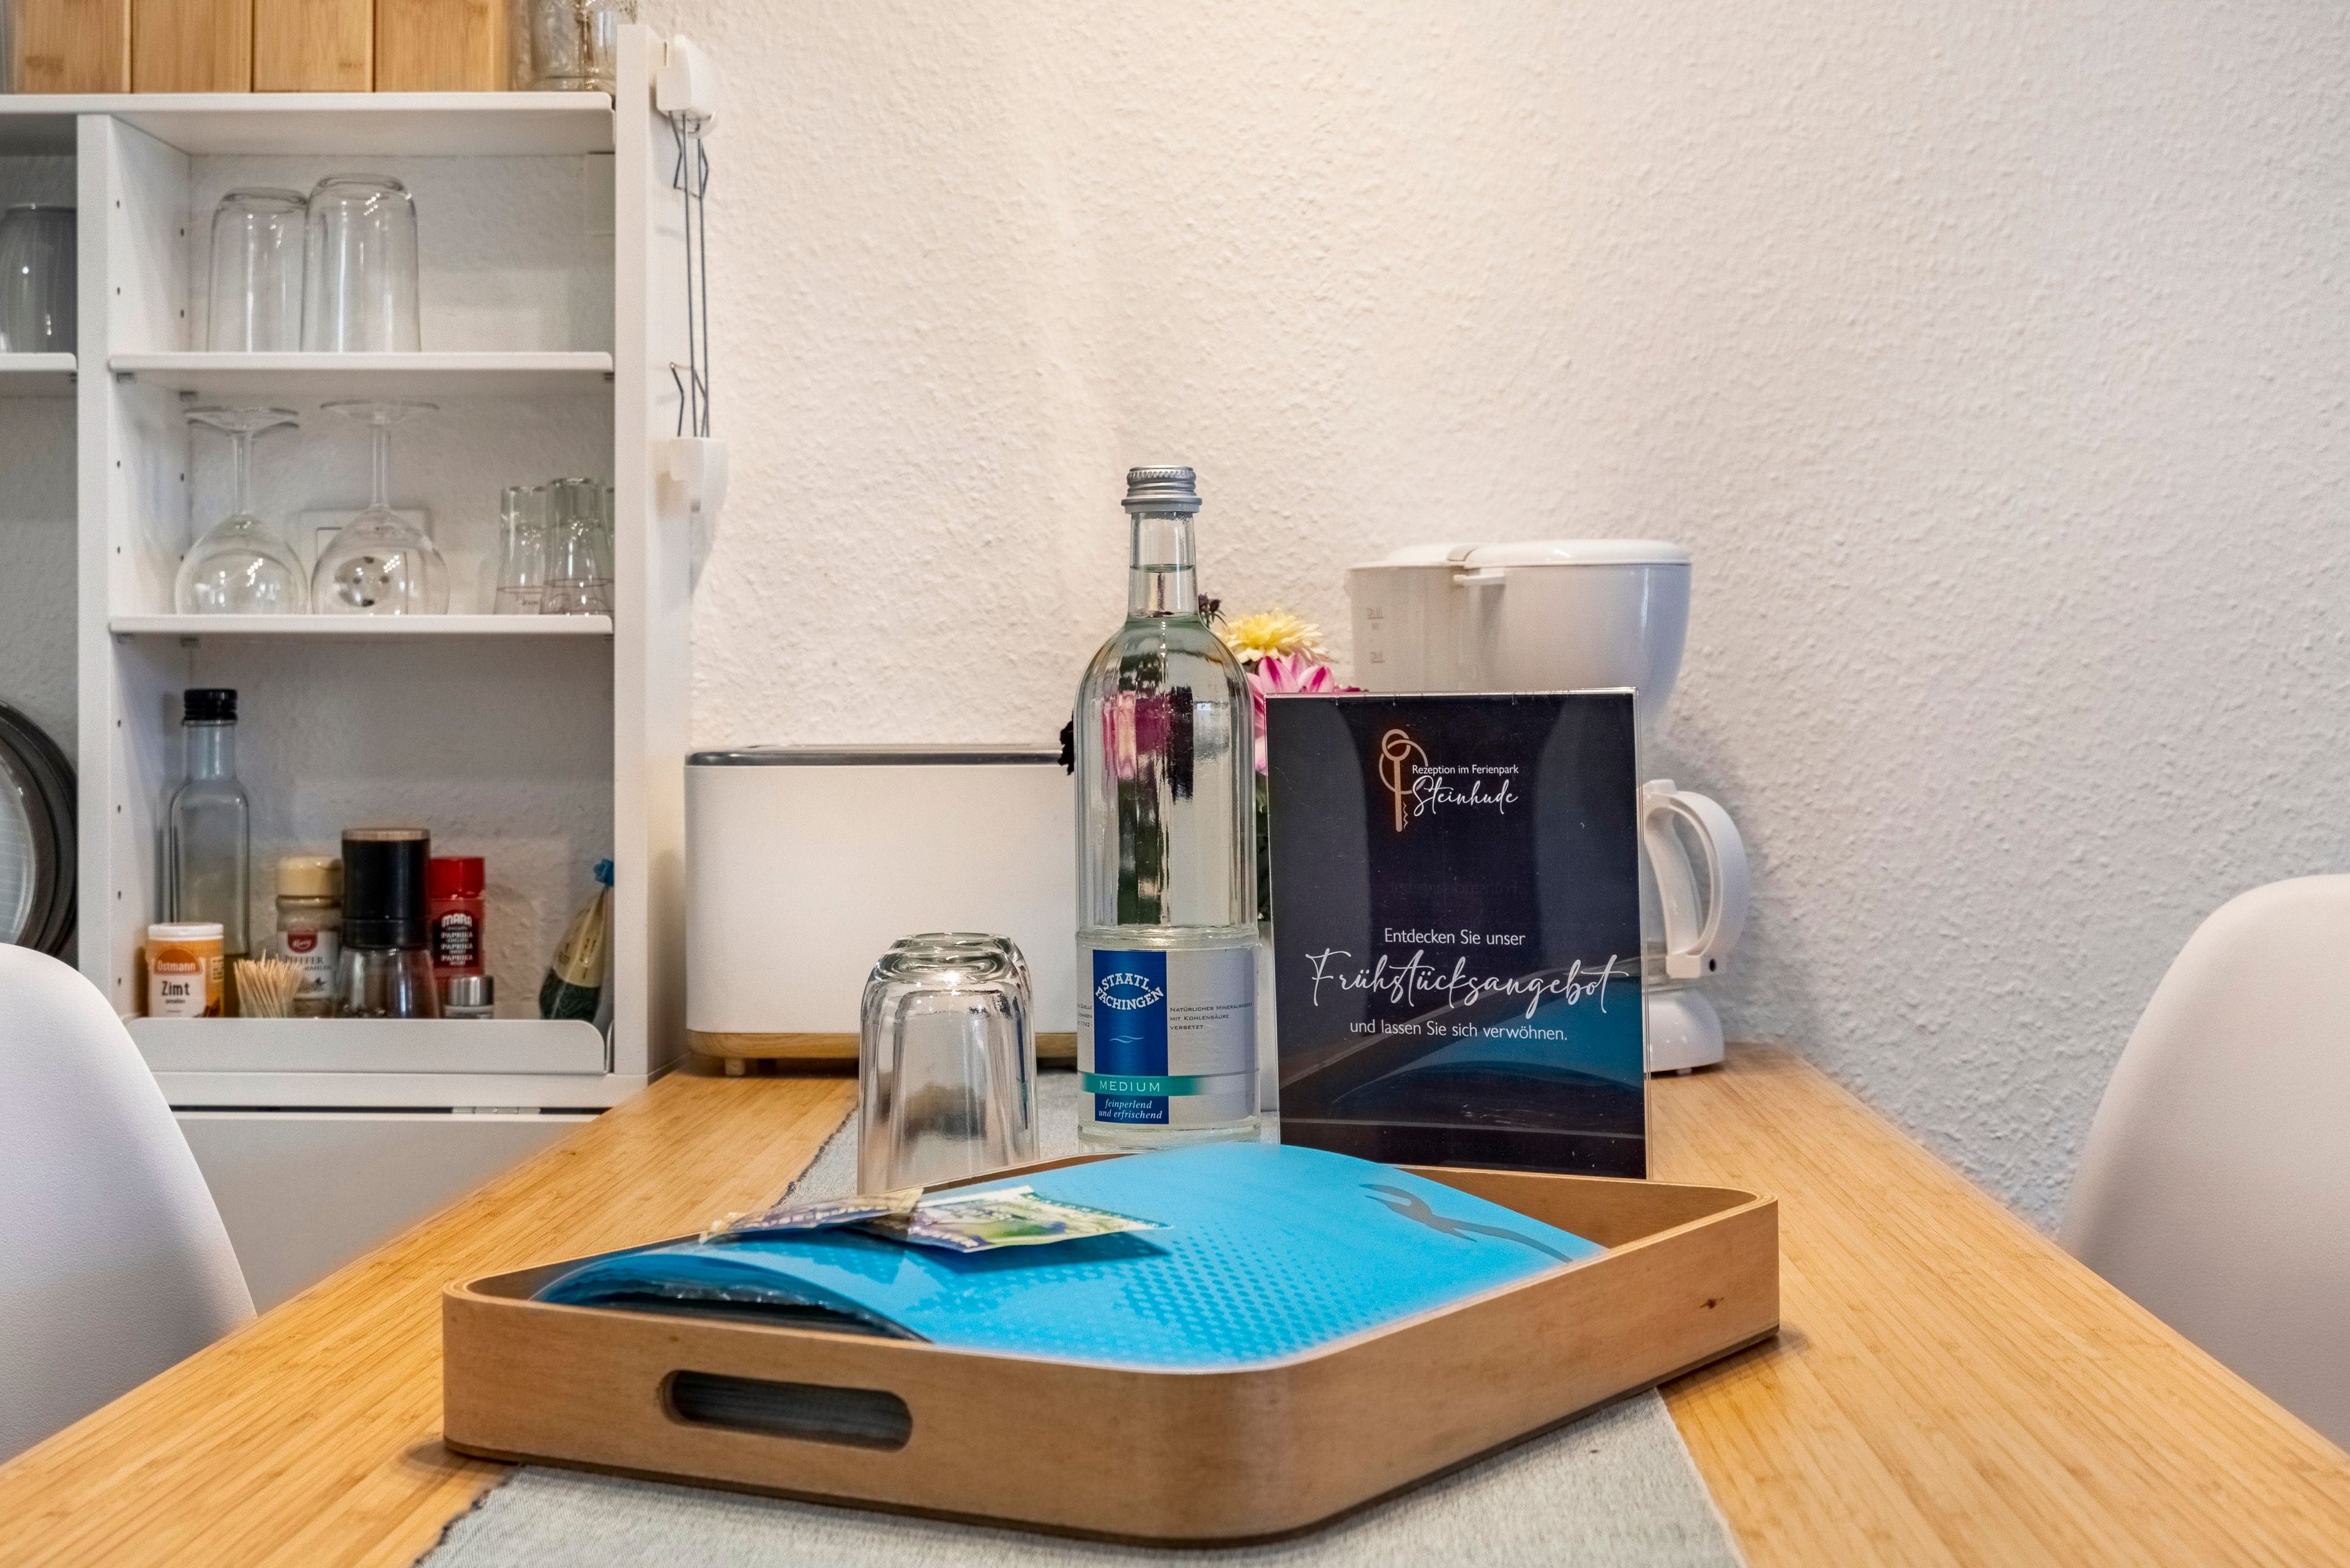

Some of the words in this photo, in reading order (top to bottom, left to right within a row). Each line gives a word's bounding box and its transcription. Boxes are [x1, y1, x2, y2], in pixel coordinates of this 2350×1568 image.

[1412, 764, 1456, 777] Rezeption
[1458, 765, 1469, 774] im
[1471, 764, 1520, 777] Ferienpark
[1412, 775, 1519, 817] Steinhude
[1384, 928, 1455, 944] Entdecken
[1460, 929, 1482, 945] Sie
[1486, 932, 1526, 946] unser
[157, 960, 196, 972] Ostmann
[162, 980, 190, 996] Zimt
[1101, 973, 1151, 992] STAATL.
[1305, 947, 1630, 1020] Frühstücksangebot
[1094, 986, 1165, 1010] FACHINGEN
[1349, 1019, 1376, 1034] und
[1381, 1019, 1422, 1035] lassen
[1427, 1020, 1447, 1036] Sie
[1452, 1022, 1478, 1037] sich
[1482, 1025, 1568, 1040] verwöhnen.
[1099, 1080, 1160, 1092] MEDIUM
[1104, 1099, 1153, 1110] feinperlend
[1098, 1108, 1113, 1118] und
[1113, 1110, 1163, 1121] erfrischend
